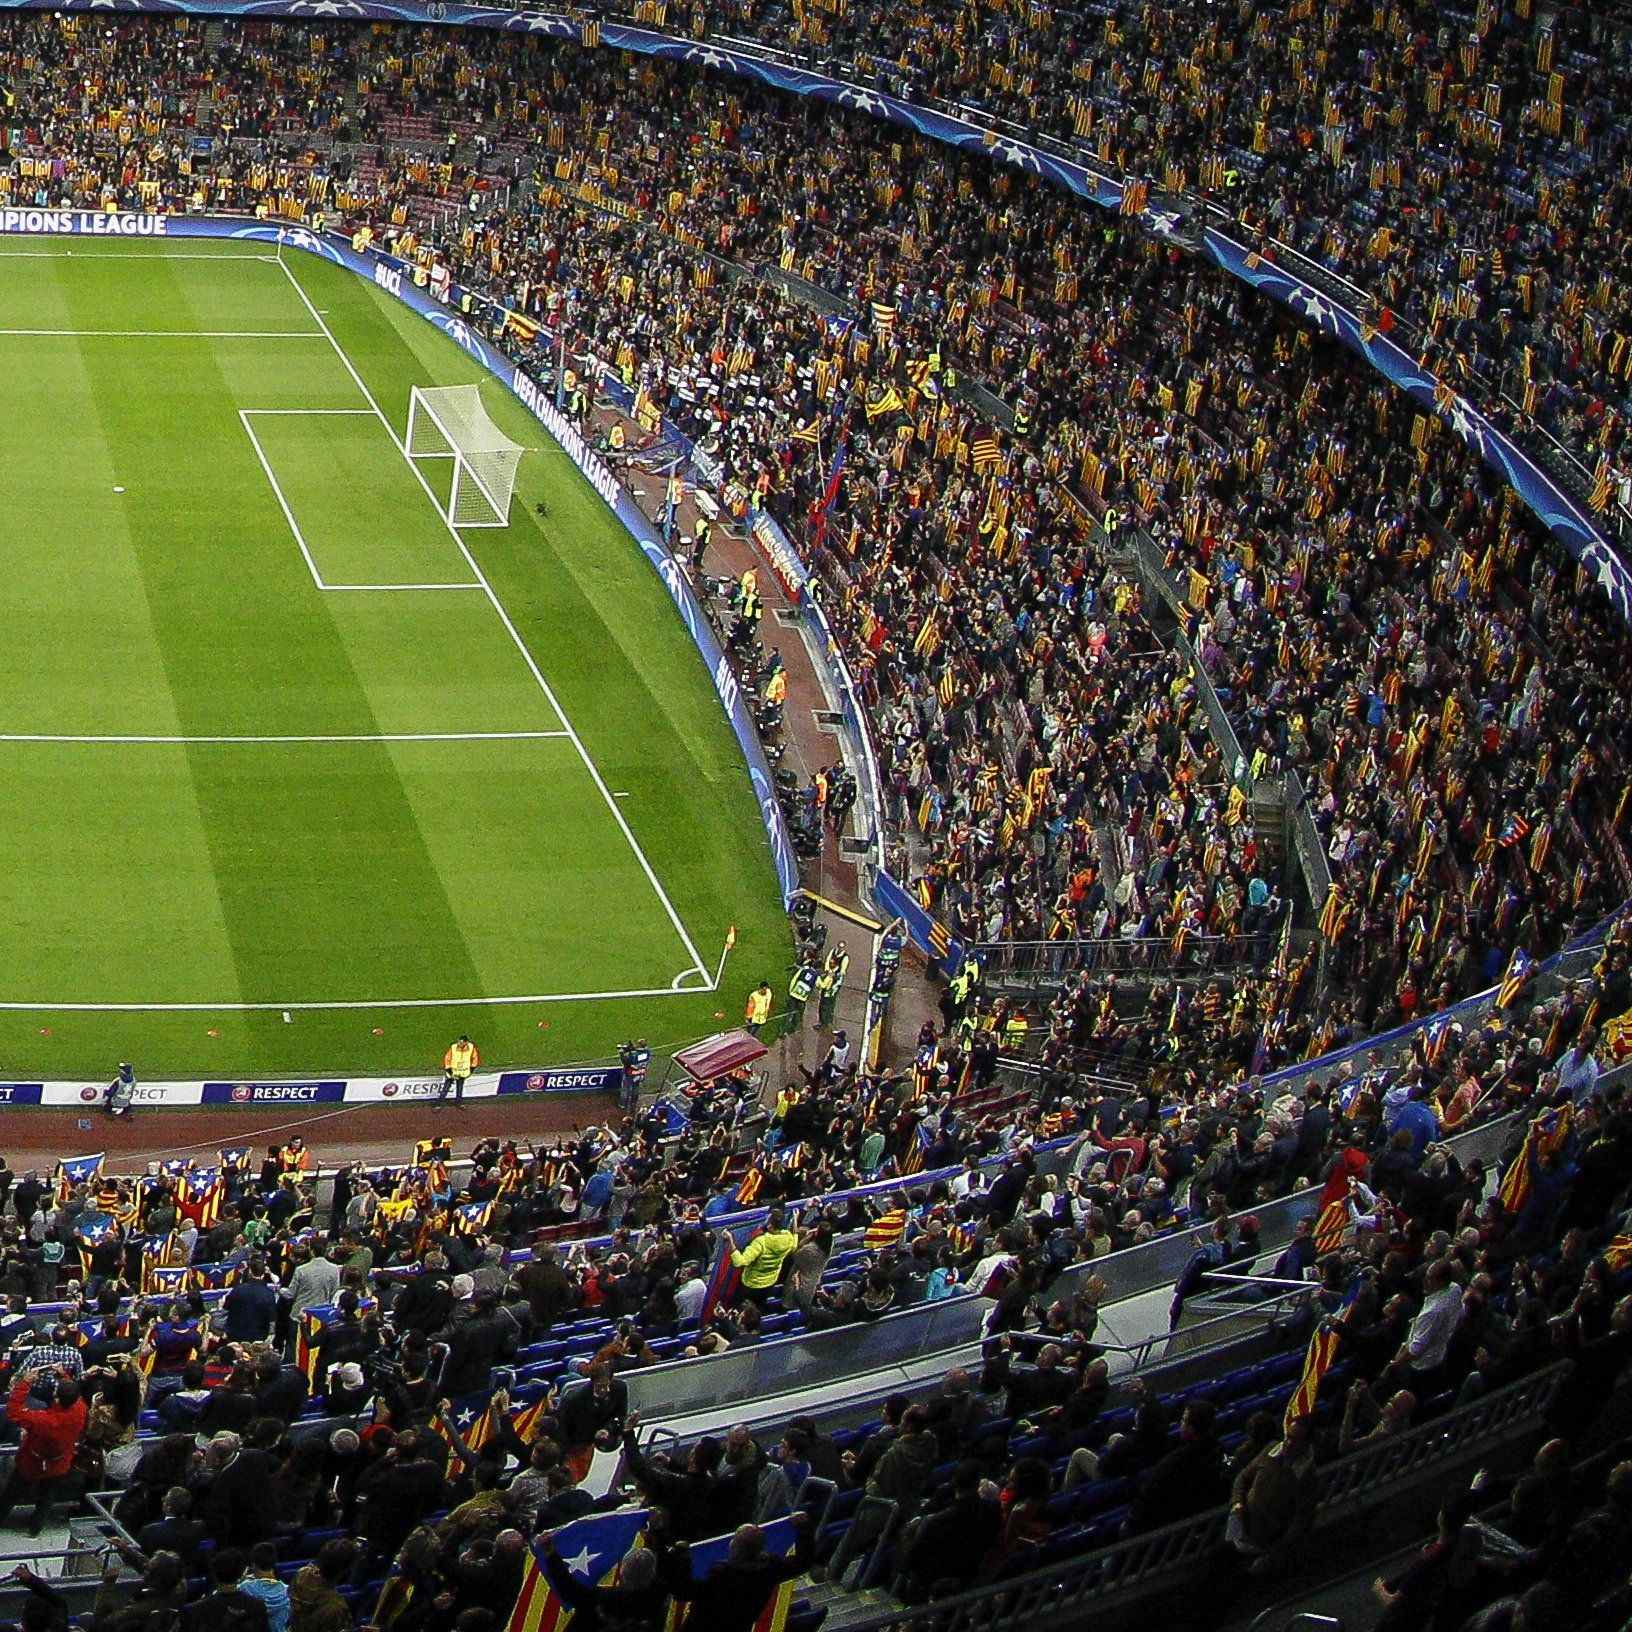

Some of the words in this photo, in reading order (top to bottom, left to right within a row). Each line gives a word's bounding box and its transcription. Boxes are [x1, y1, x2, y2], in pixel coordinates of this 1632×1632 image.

[79, 213, 168, 235] LEAGUE
[583, 447, 621, 510] LEAGUE
[546, 1073, 609, 1089] RESPECT
[253, 1085, 319, 1100] RESPECT
